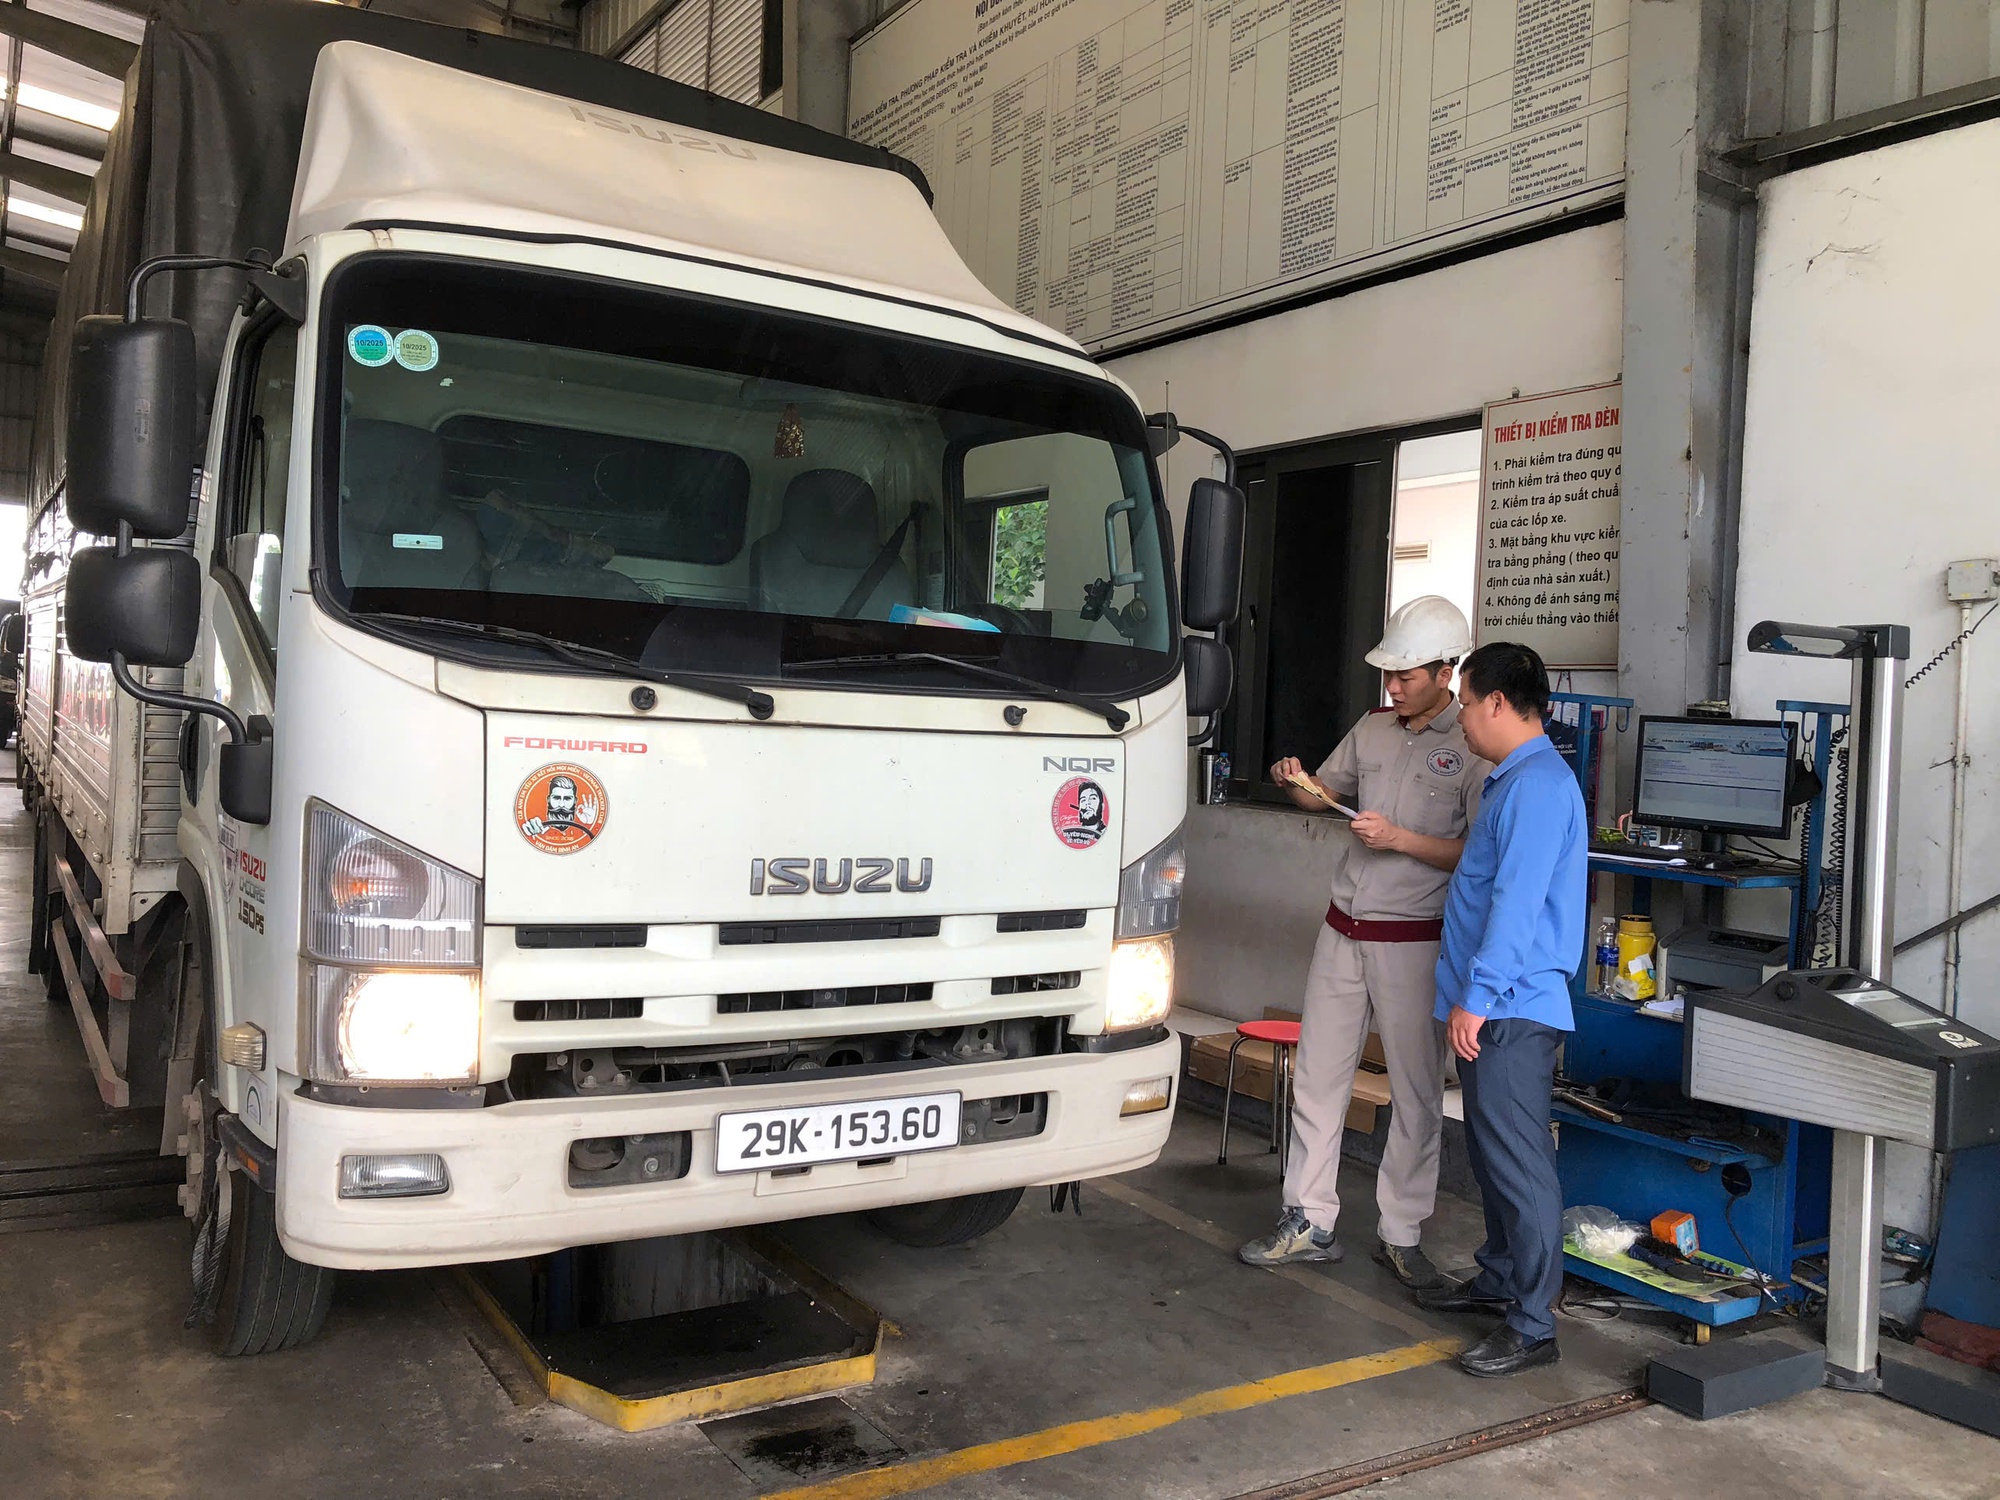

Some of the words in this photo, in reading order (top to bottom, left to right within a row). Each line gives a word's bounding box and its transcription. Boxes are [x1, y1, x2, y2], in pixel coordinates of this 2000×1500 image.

[940, 56, 954, 74] KIỂM
[956, 50, 967, 63] TRA
[568, 105, 757, 160] ISUZU
[1495, 420, 1522, 443] THIẾT
[1526, 422, 1536, 441] BỊ
[1539, 411, 1568, 436] KIỂM
[1571, 412, 1592, 432] TRA
[1595, 406, 1620, 428] ĐÈN
[1494, 461, 1501, 471] 1.
[1504, 456, 1526, 470] Phải
[1530, 452, 1554, 466] kiểm
[1558, 452, 1572, 462] tra
[1576, 448, 1604, 460] đúng
[1492, 478, 1515, 490] trình
[1518, 474, 1542, 488] kiểm
[1564, 470, 1587, 482] theo
[1591, 468, 1612, 481] quy
[1491, 500, 1500, 510] 2.
[1502, 495, 1528, 509] Kiểm
[1532, 496, 1545, 506] tra
[1548, 493, 1562, 506] áp
[1564, 487, 1588, 502] suất
[1490, 518, 1508, 530] của
[1510, 516, 1528, 528] các
[1532, 512, 1548, 527] lốp
[1551, 514, 1566, 524] xe.
[1489, 538, 1498, 549] 3.
[1500, 537, 1518, 550] Mặt
[1522, 533, 1548, 548] bằng
[1551, 533, 1570, 544] khu
[1574, 532, 1596, 544] vực
[1488, 558, 1500, 568] tra
[1504, 554, 1530, 568] bằng
[1532, 551, 1566, 568] phẳng
[1576, 551, 1600, 562] theo
[1486, 577, 1508, 590] định
[1512, 575, 1530, 586] của
[1534, 573, 1553, 586] nhà
[1556, 572, 1576, 584] sản
[1578, 568, 1610, 584] xuất.)
[1485, 598, 1494, 608] 4.
[1498, 594, 1530, 608] Không
[1534, 592, 1547, 605] để
[1550, 592, 1570, 604] ánh
[1574, 592, 1600, 604] sáng
[1484, 612, 1502, 626] trời
[1506, 612, 1533, 626] chiếu
[1536, 610, 1567, 626] thẳng
[1570, 612, 1590, 624] vào
[1594, 608, 1619, 623] thiết
[504, 736, 648, 754] FORWARD
[1043, 756, 1115, 774] NQR
[240, 850, 266, 882] ISUZU
[750, 857, 933, 895] ISUZU
[740, 1104, 942, 1159] 29K-153.60
